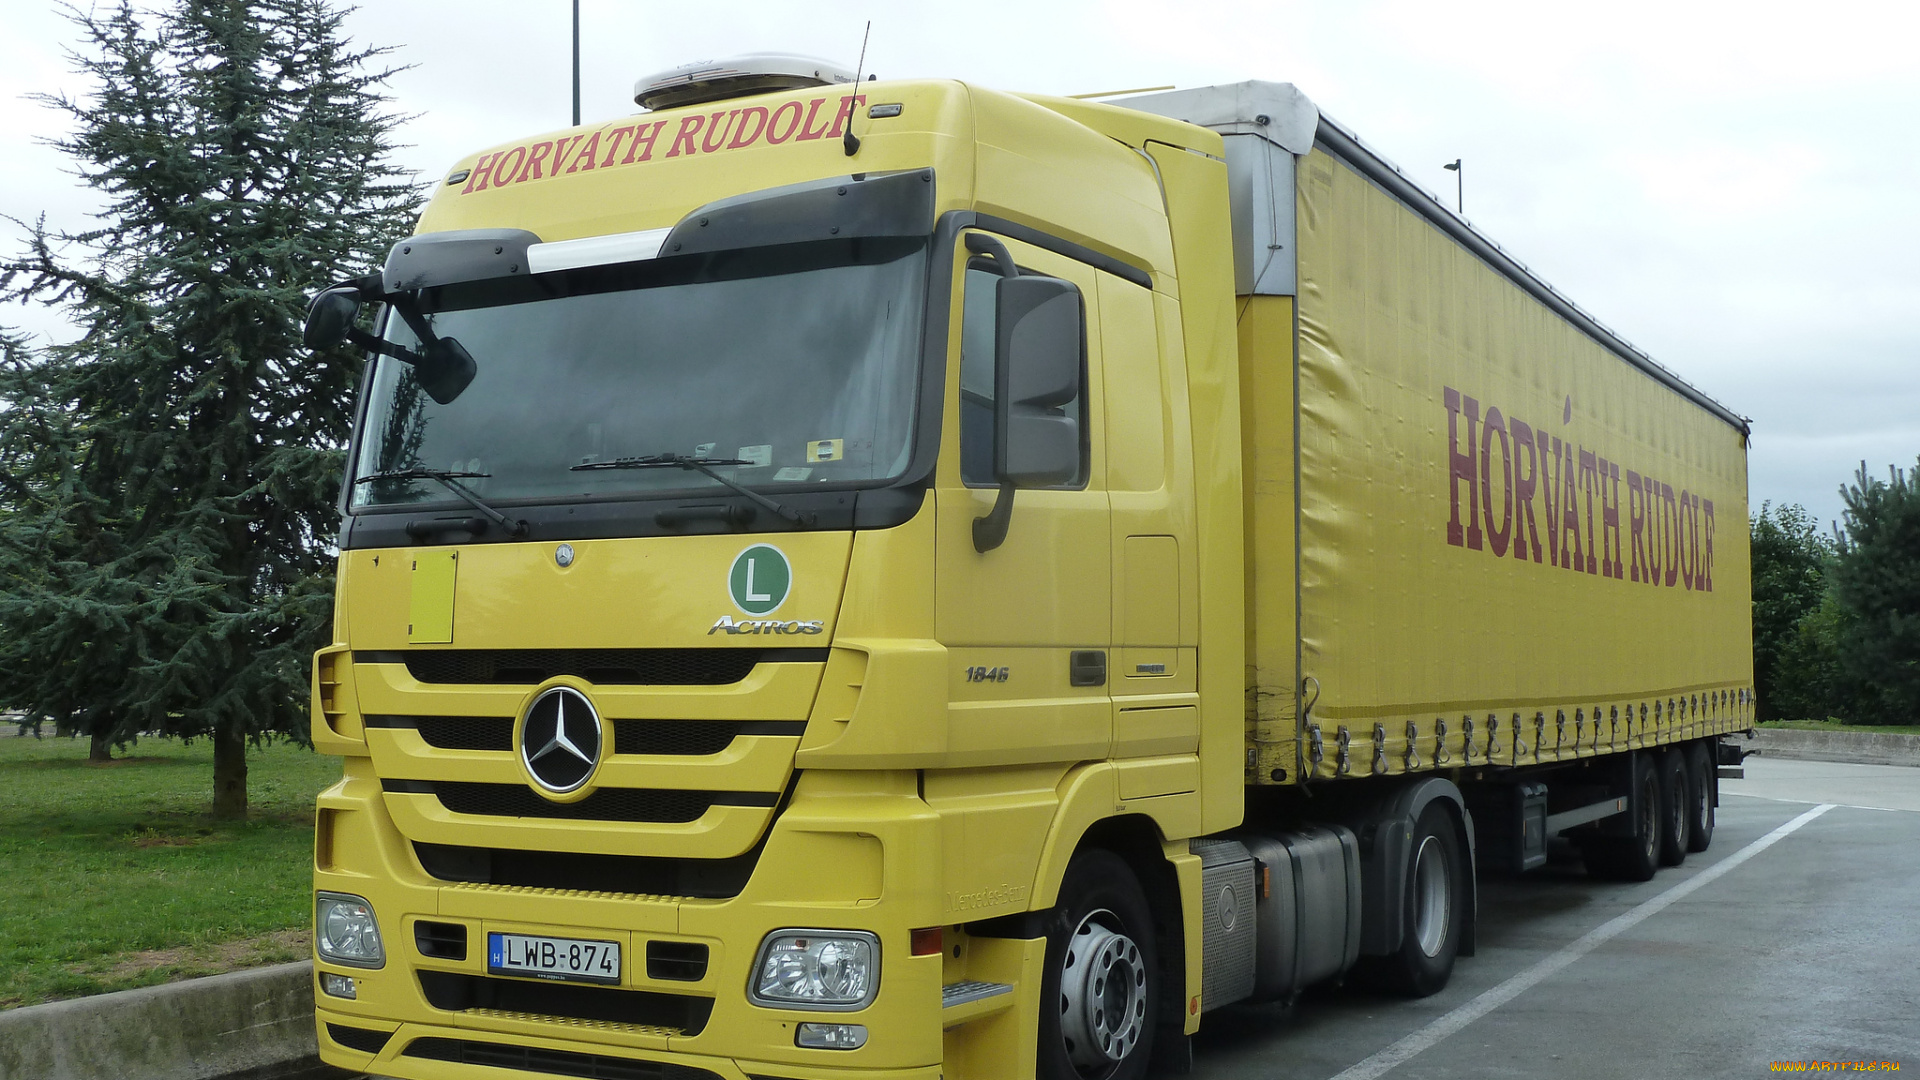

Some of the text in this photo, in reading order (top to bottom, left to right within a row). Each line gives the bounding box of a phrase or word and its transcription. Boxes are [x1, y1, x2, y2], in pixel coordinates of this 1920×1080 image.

[666, 94, 866, 158] RUDOLF
[1443, 385, 1715, 592] HORVÁTH RUDOLF
[746, 558, 771, 601] L
[965, 666, 1009, 683] 1846
[945, 883, 1026, 913] Mercedes-Benz
[493, 939, 612, 973] H LWB-874
